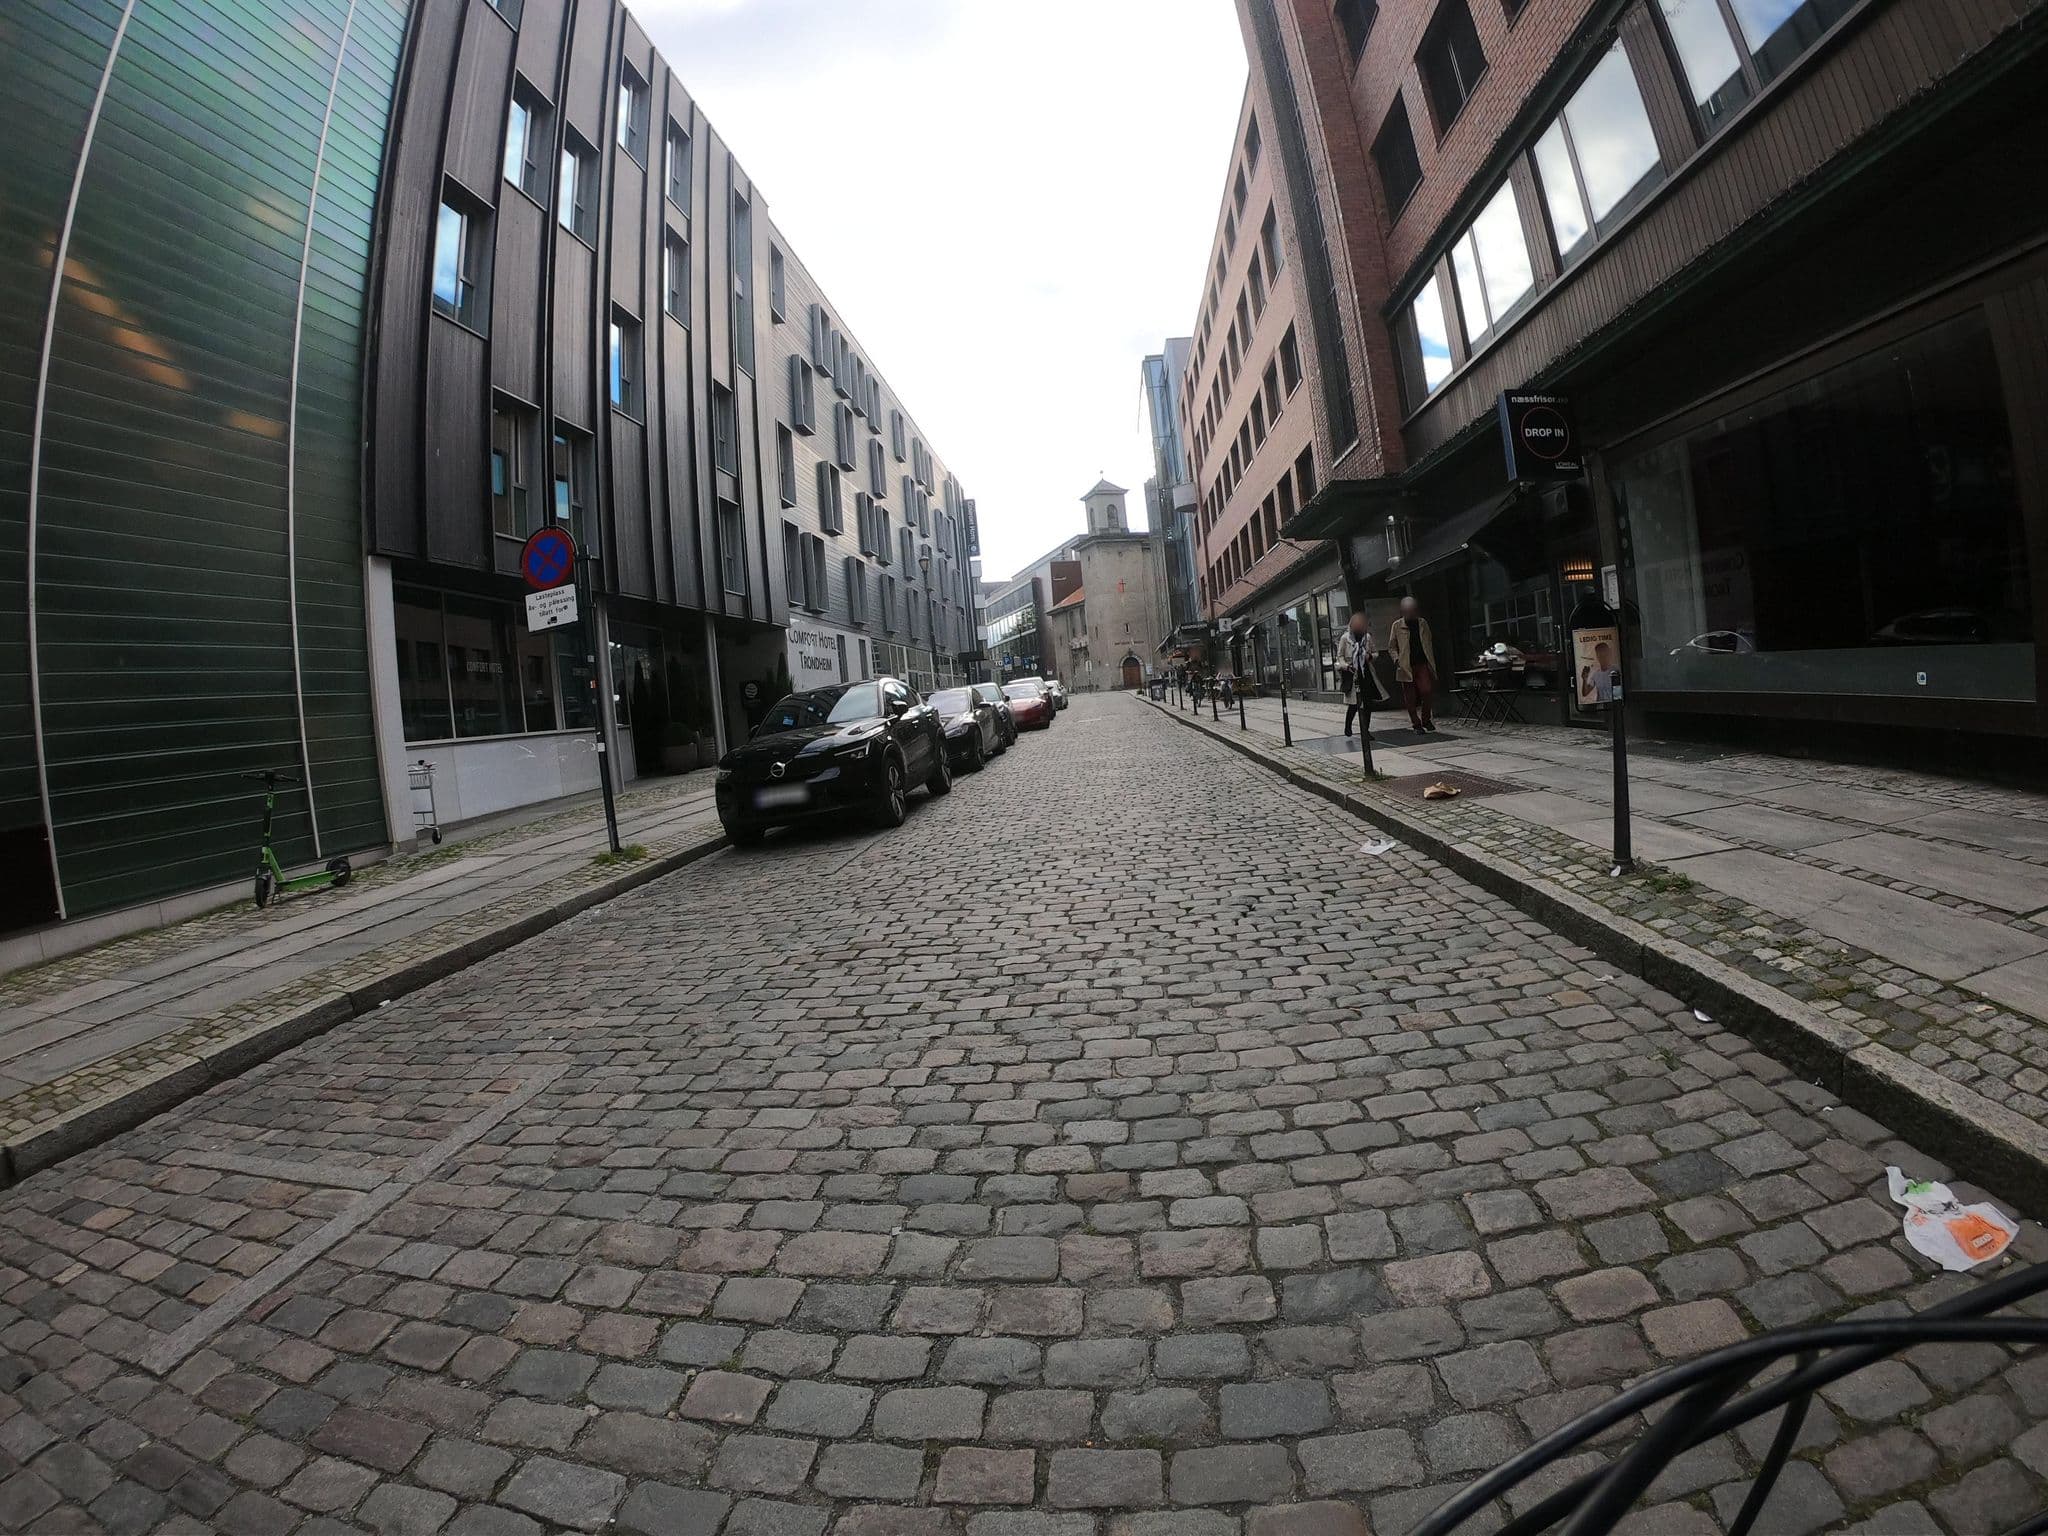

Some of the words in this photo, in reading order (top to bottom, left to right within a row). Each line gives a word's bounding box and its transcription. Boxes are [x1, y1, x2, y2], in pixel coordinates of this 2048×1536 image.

[1525, 428, 1552, 437] DROP
[1554, 428, 1564, 437] IN
[536, 590, 565, 600] Lasteplass
